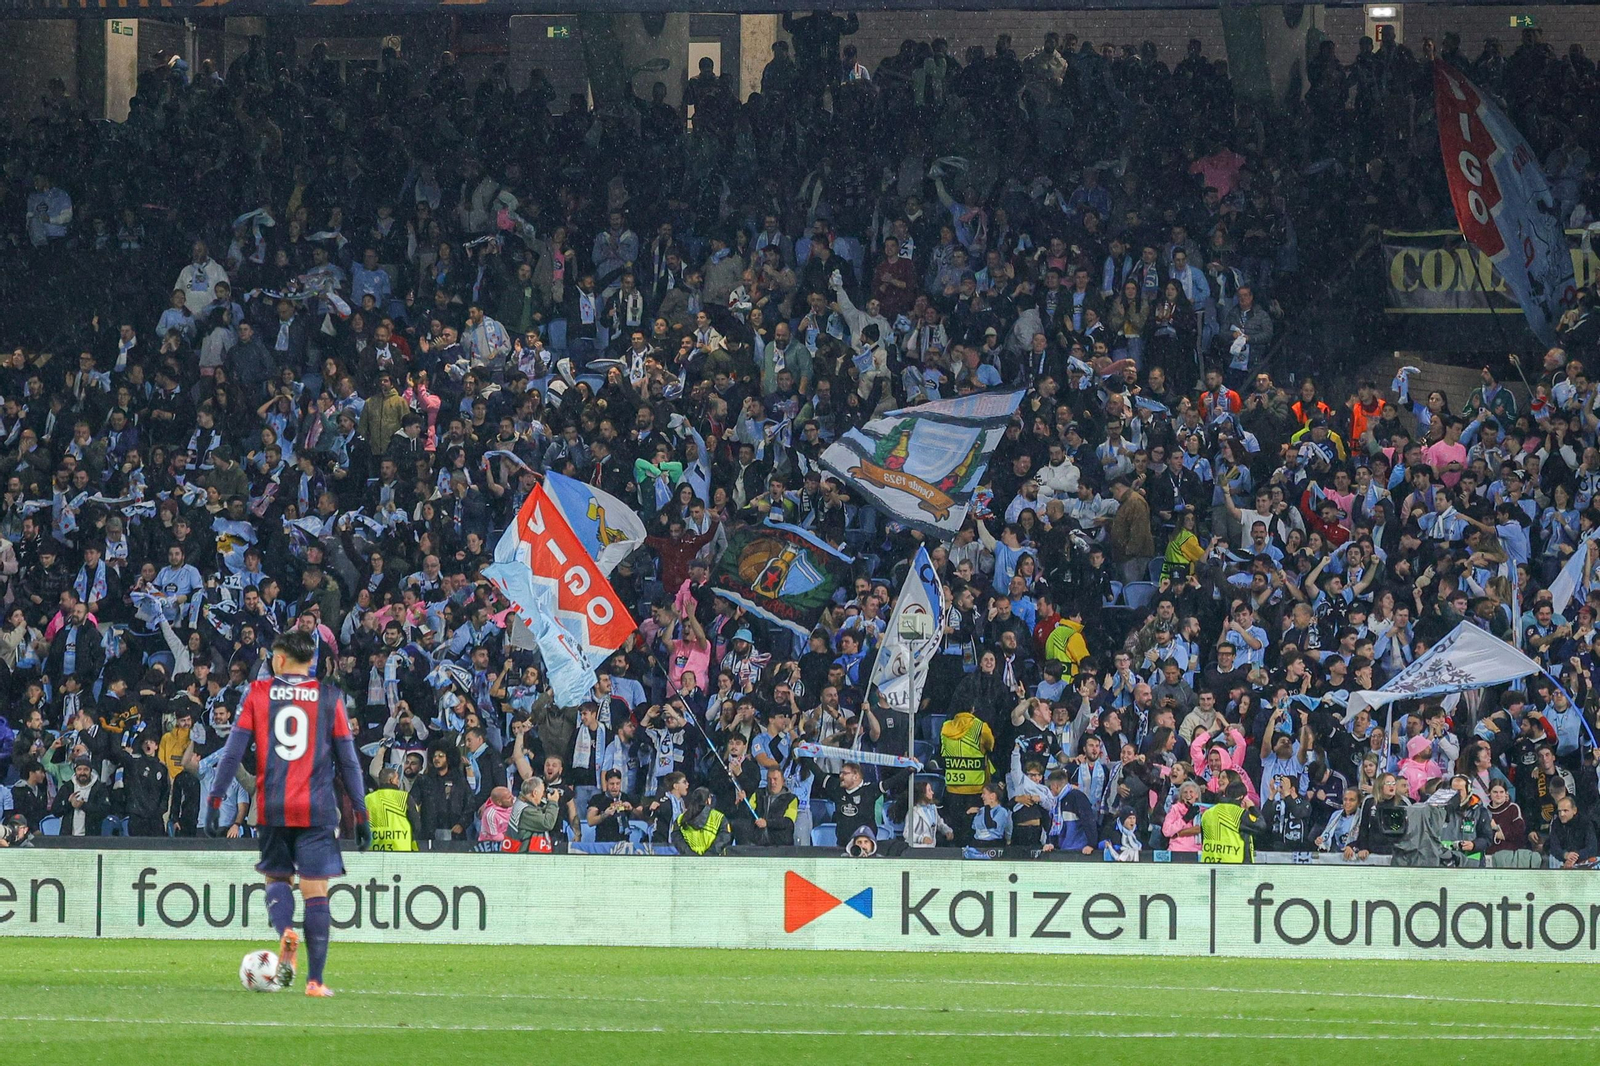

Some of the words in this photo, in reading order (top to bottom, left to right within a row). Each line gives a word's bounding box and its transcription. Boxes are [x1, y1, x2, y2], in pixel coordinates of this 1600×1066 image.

[269, 687, 319, 702] CASTRO
[274, 705, 309, 761] 9
[945, 758, 982, 769] EWARD
[372, 830, 408, 840] CURITY
[1203, 843, 1240, 855] CURITY
[131, 867, 487, 931] founation
[901, 871, 1177, 940] kaizen
